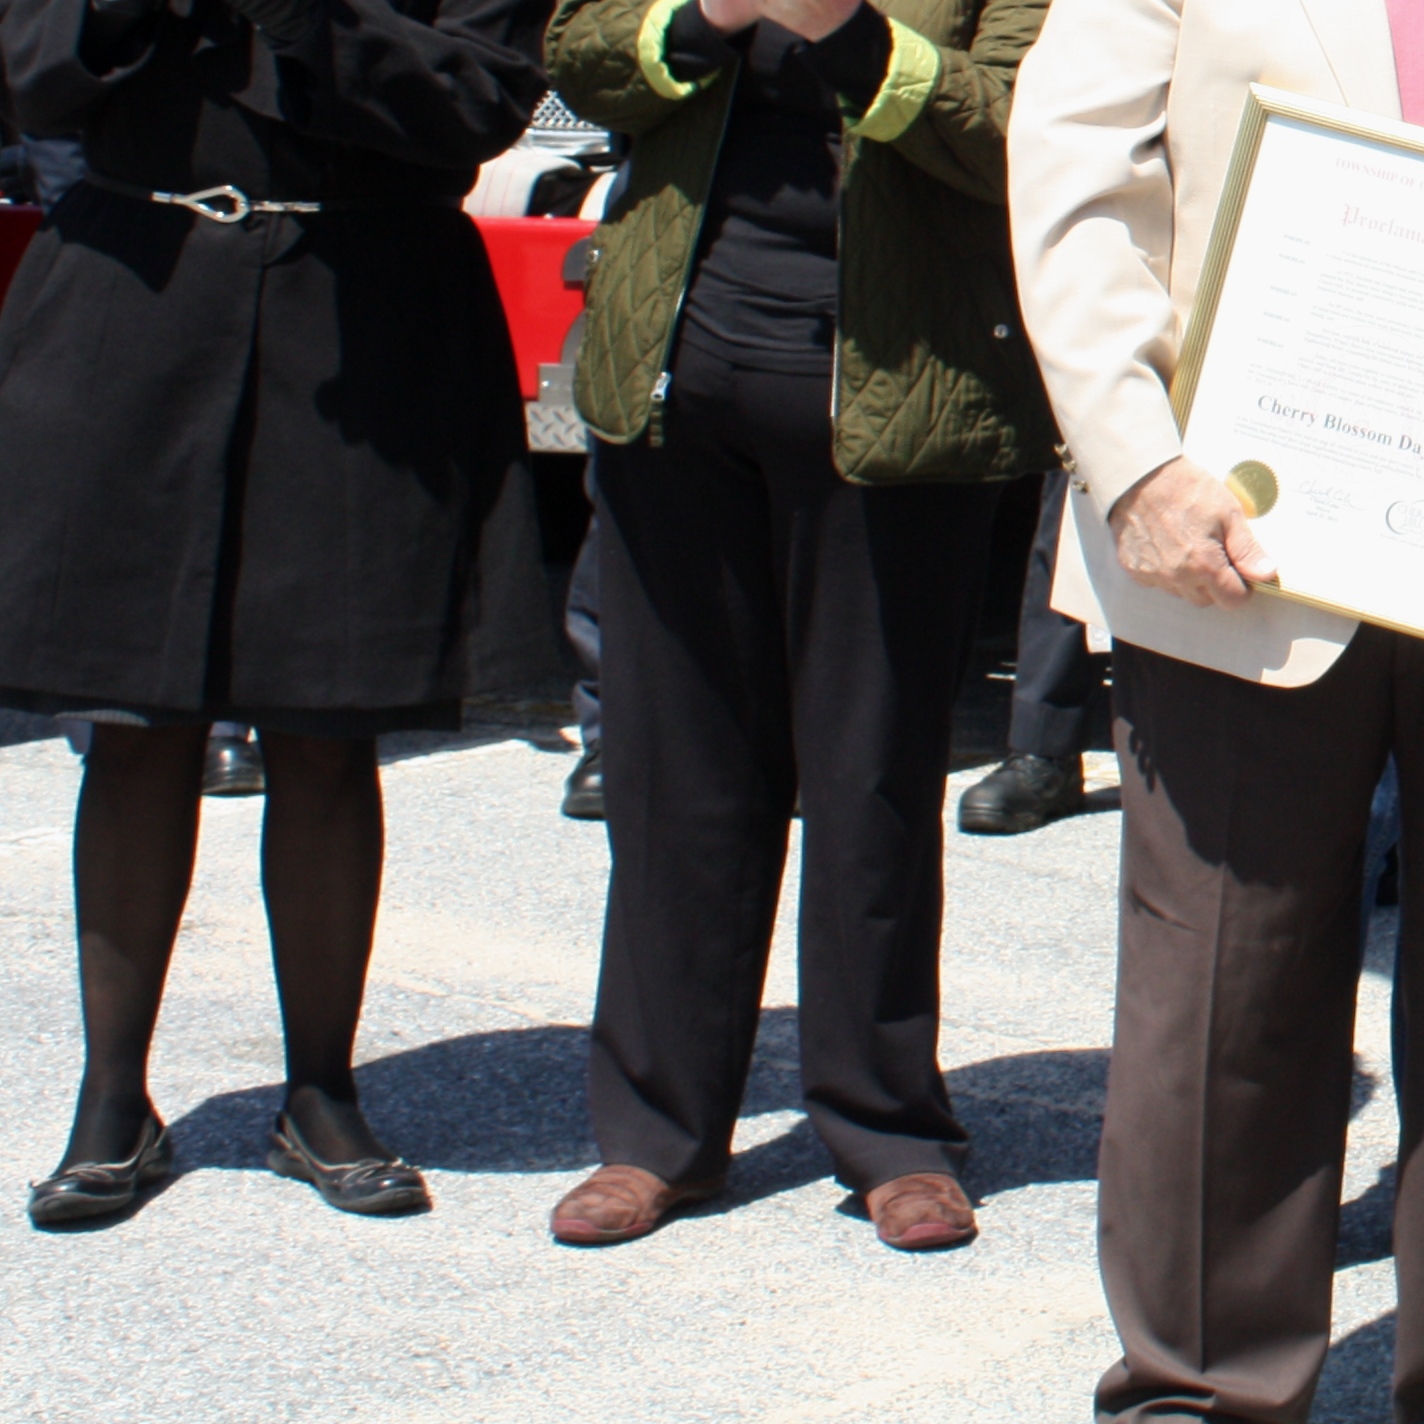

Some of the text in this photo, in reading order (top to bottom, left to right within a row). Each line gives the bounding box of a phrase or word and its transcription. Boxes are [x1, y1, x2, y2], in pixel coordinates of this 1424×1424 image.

[1333, 156, 1398, 182] TOWNSHIP
[1398, 174, 1415, 187] OF
[1258, 395, 1318, 427] Cherry
[1323, 413, 1392, 446] Blossom
